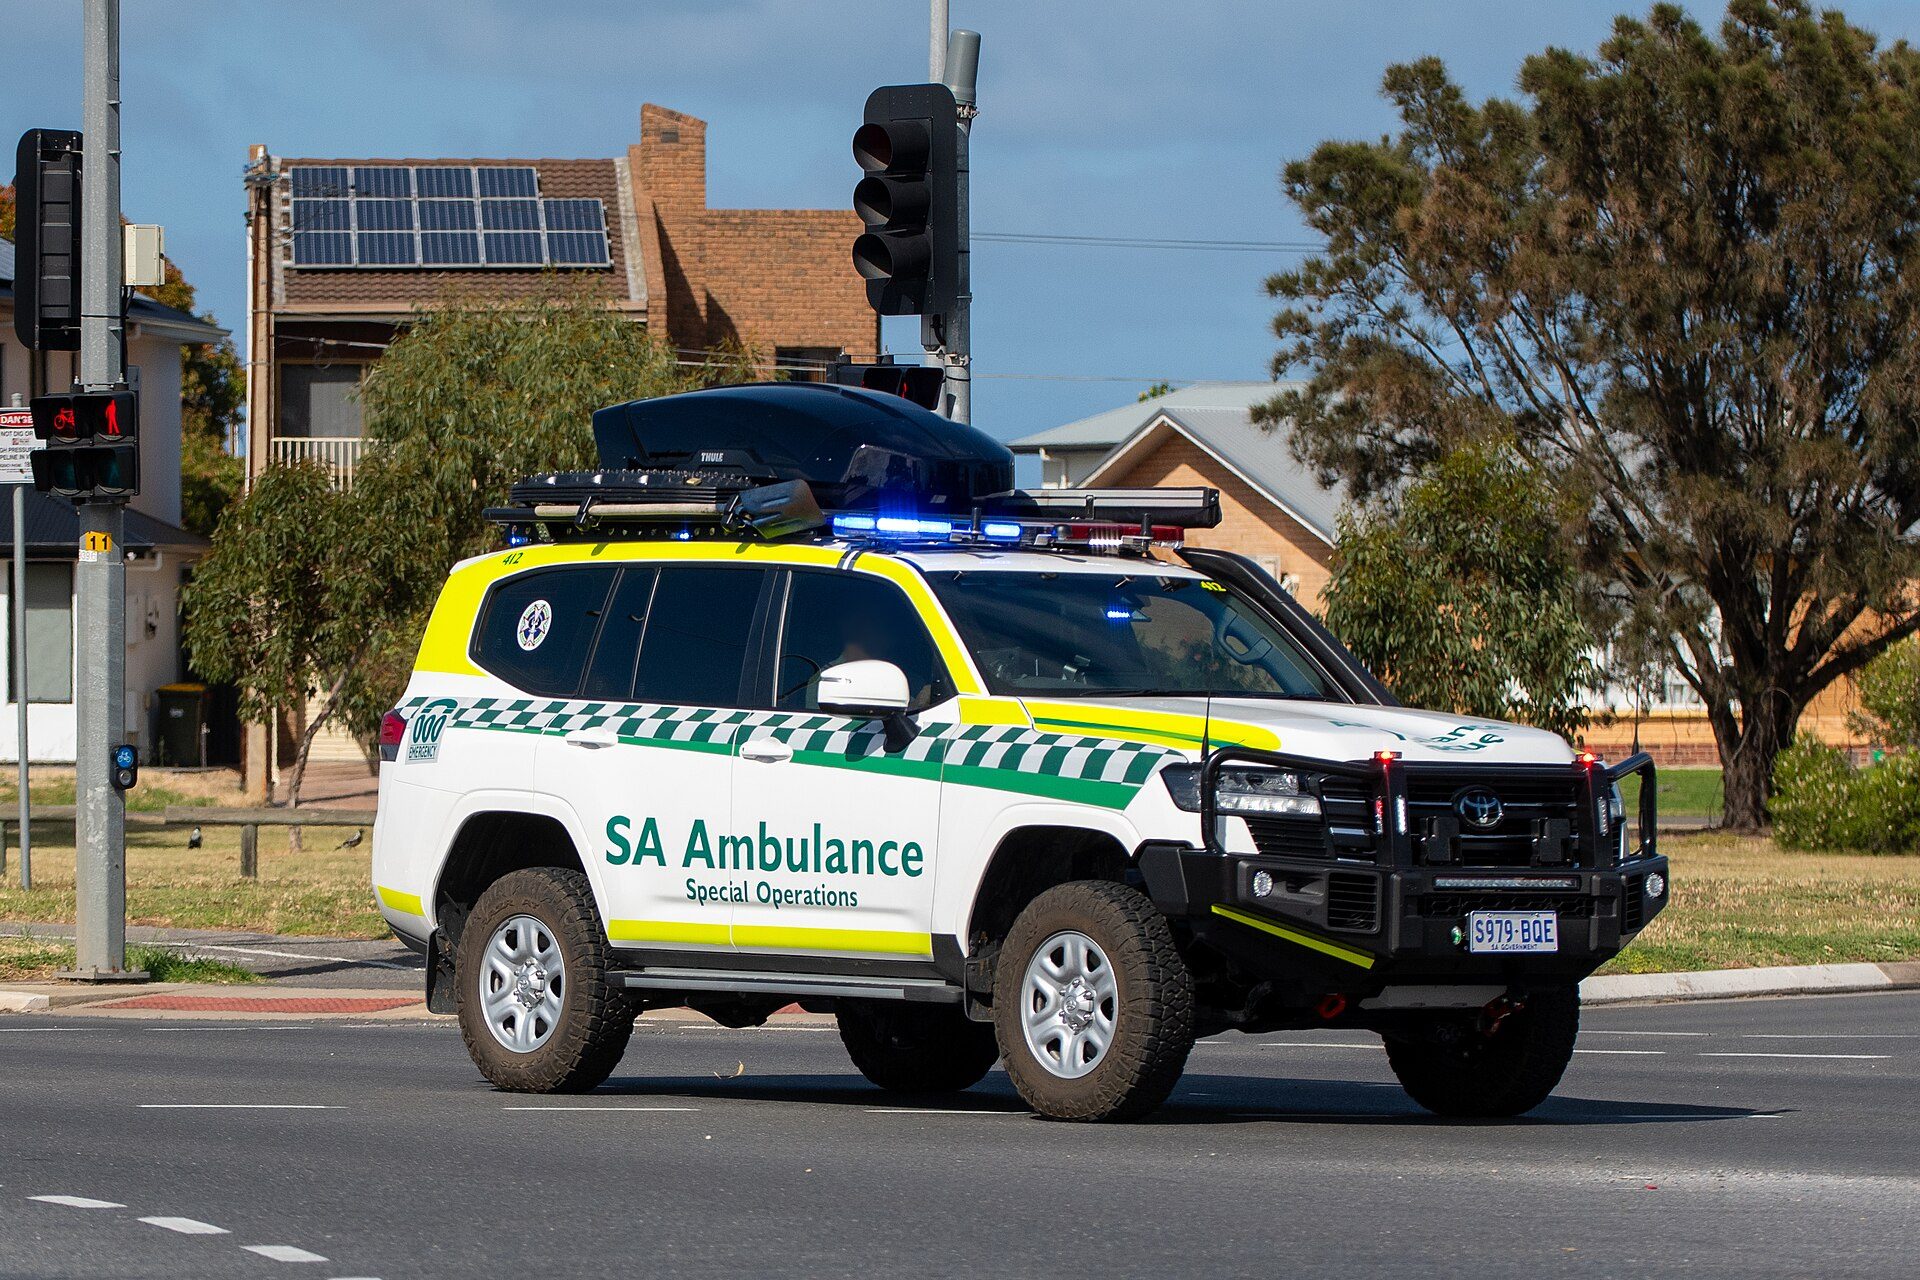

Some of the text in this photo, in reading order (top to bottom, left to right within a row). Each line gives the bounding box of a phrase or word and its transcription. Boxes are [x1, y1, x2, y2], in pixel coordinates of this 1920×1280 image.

[1, 415, 33, 424] DANGE
[701, 452, 724, 462] THULE
[502, 552, 524, 566] 412
[1200, 580, 1227, 592] 412
[412, 714, 448, 744] 000
[408, 745, 437, 759] EMERGENCY
[605, 815, 924, 877] SA Ambulance
[685, 877, 858, 909] Special Operations
